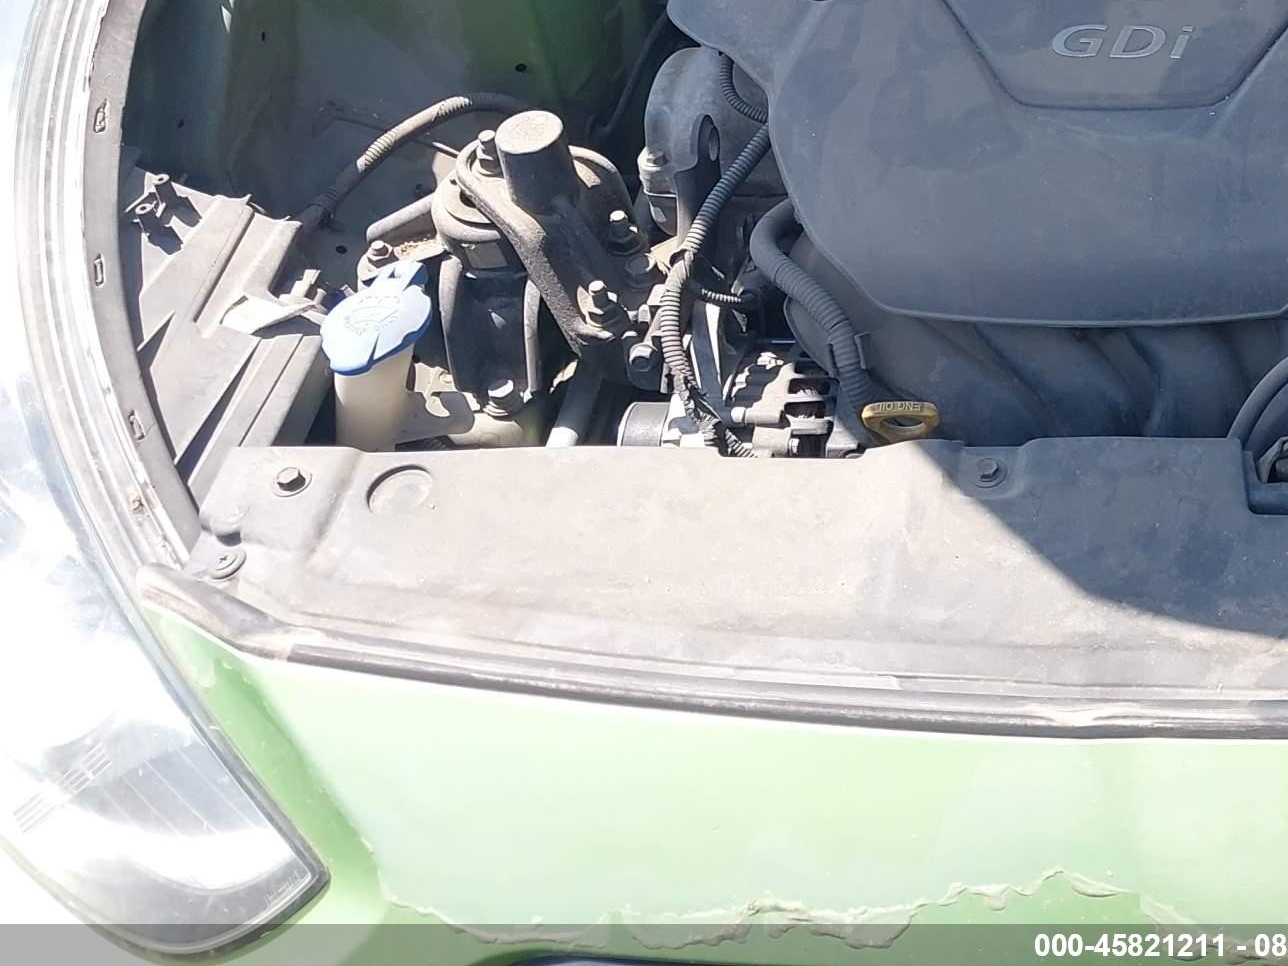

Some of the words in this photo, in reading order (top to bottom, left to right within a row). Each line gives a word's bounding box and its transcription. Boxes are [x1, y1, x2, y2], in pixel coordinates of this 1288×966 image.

[1051, 24, 1196, 59] GDi
[879, 401, 894, 411] OIL
[898, 401, 921, 411] ENG
